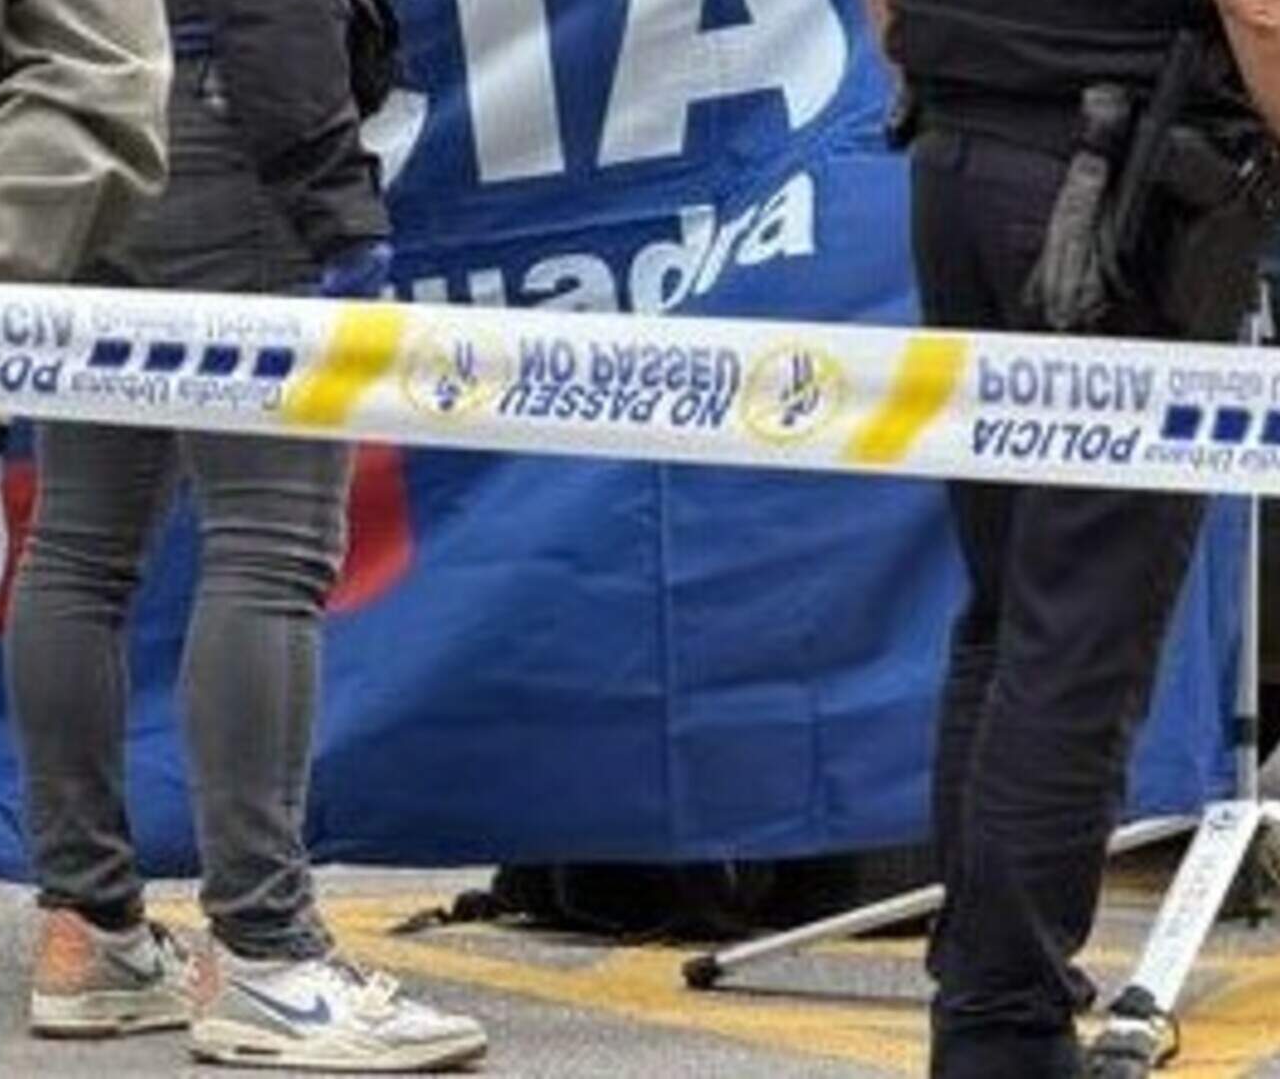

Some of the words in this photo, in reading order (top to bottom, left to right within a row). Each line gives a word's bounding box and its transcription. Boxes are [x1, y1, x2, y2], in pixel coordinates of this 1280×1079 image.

[381, 173, 814, 316] uadra
[499, 384, 663, 423] PASSEU
[671, 391, 732, 429] NO
[973, 420, 1141, 463] POLICIA
